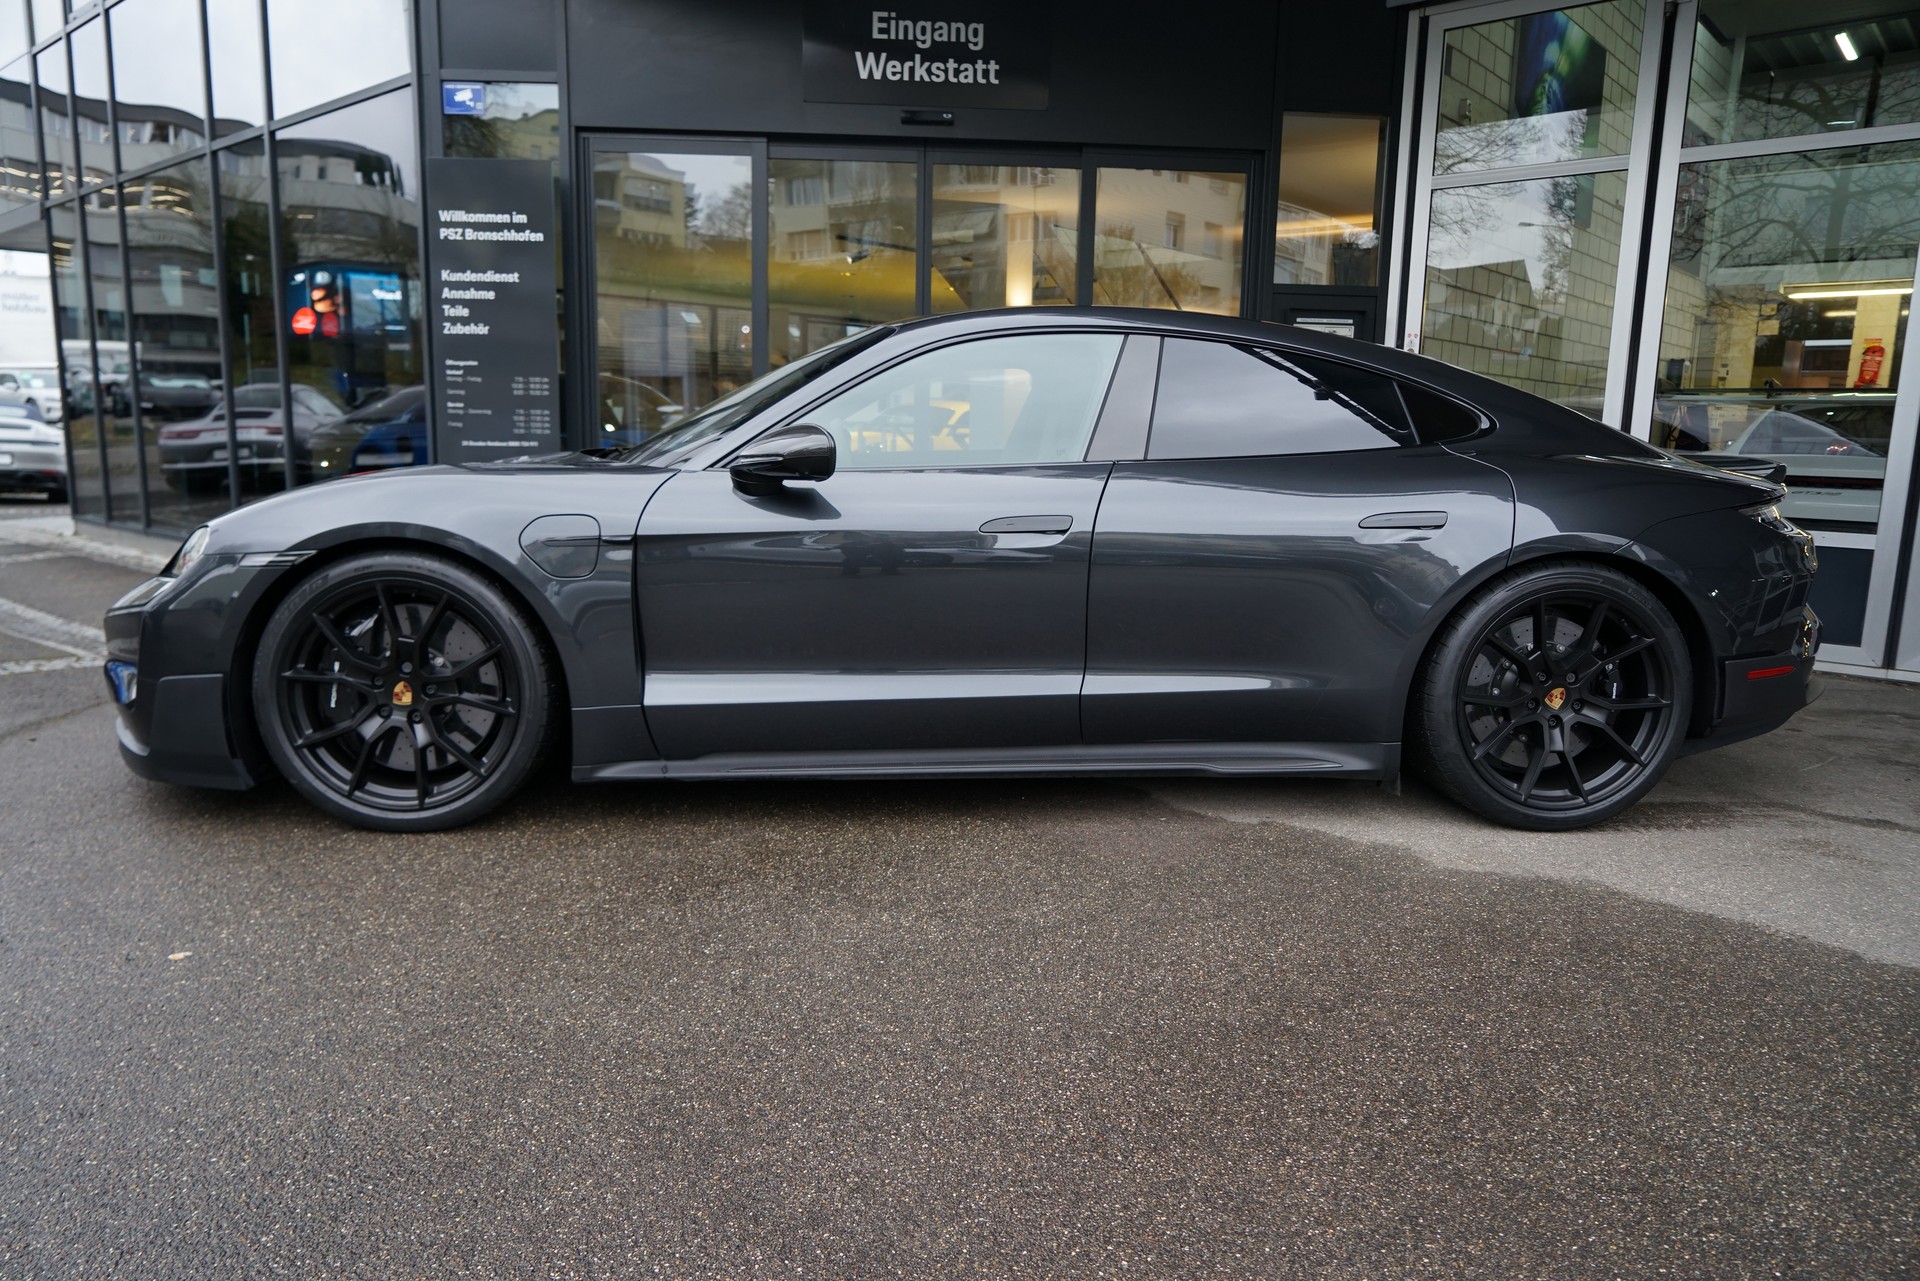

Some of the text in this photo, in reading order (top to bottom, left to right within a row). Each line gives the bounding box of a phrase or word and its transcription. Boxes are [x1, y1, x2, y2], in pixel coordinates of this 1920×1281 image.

[872, 11, 984, 51] Eingang
[855, 51, 1000, 85] Werkstatt
[438, 210, 528, 224] Willkommen im
[439, 228, 545, 242] PSZ Bronschhofen
[441, 269, 520, 283] Kundendienst
[441, 287, 496, 300] Annahme
[442, 304, 470, 317] Teile
[442, 322, 490, 335] Zubehör
